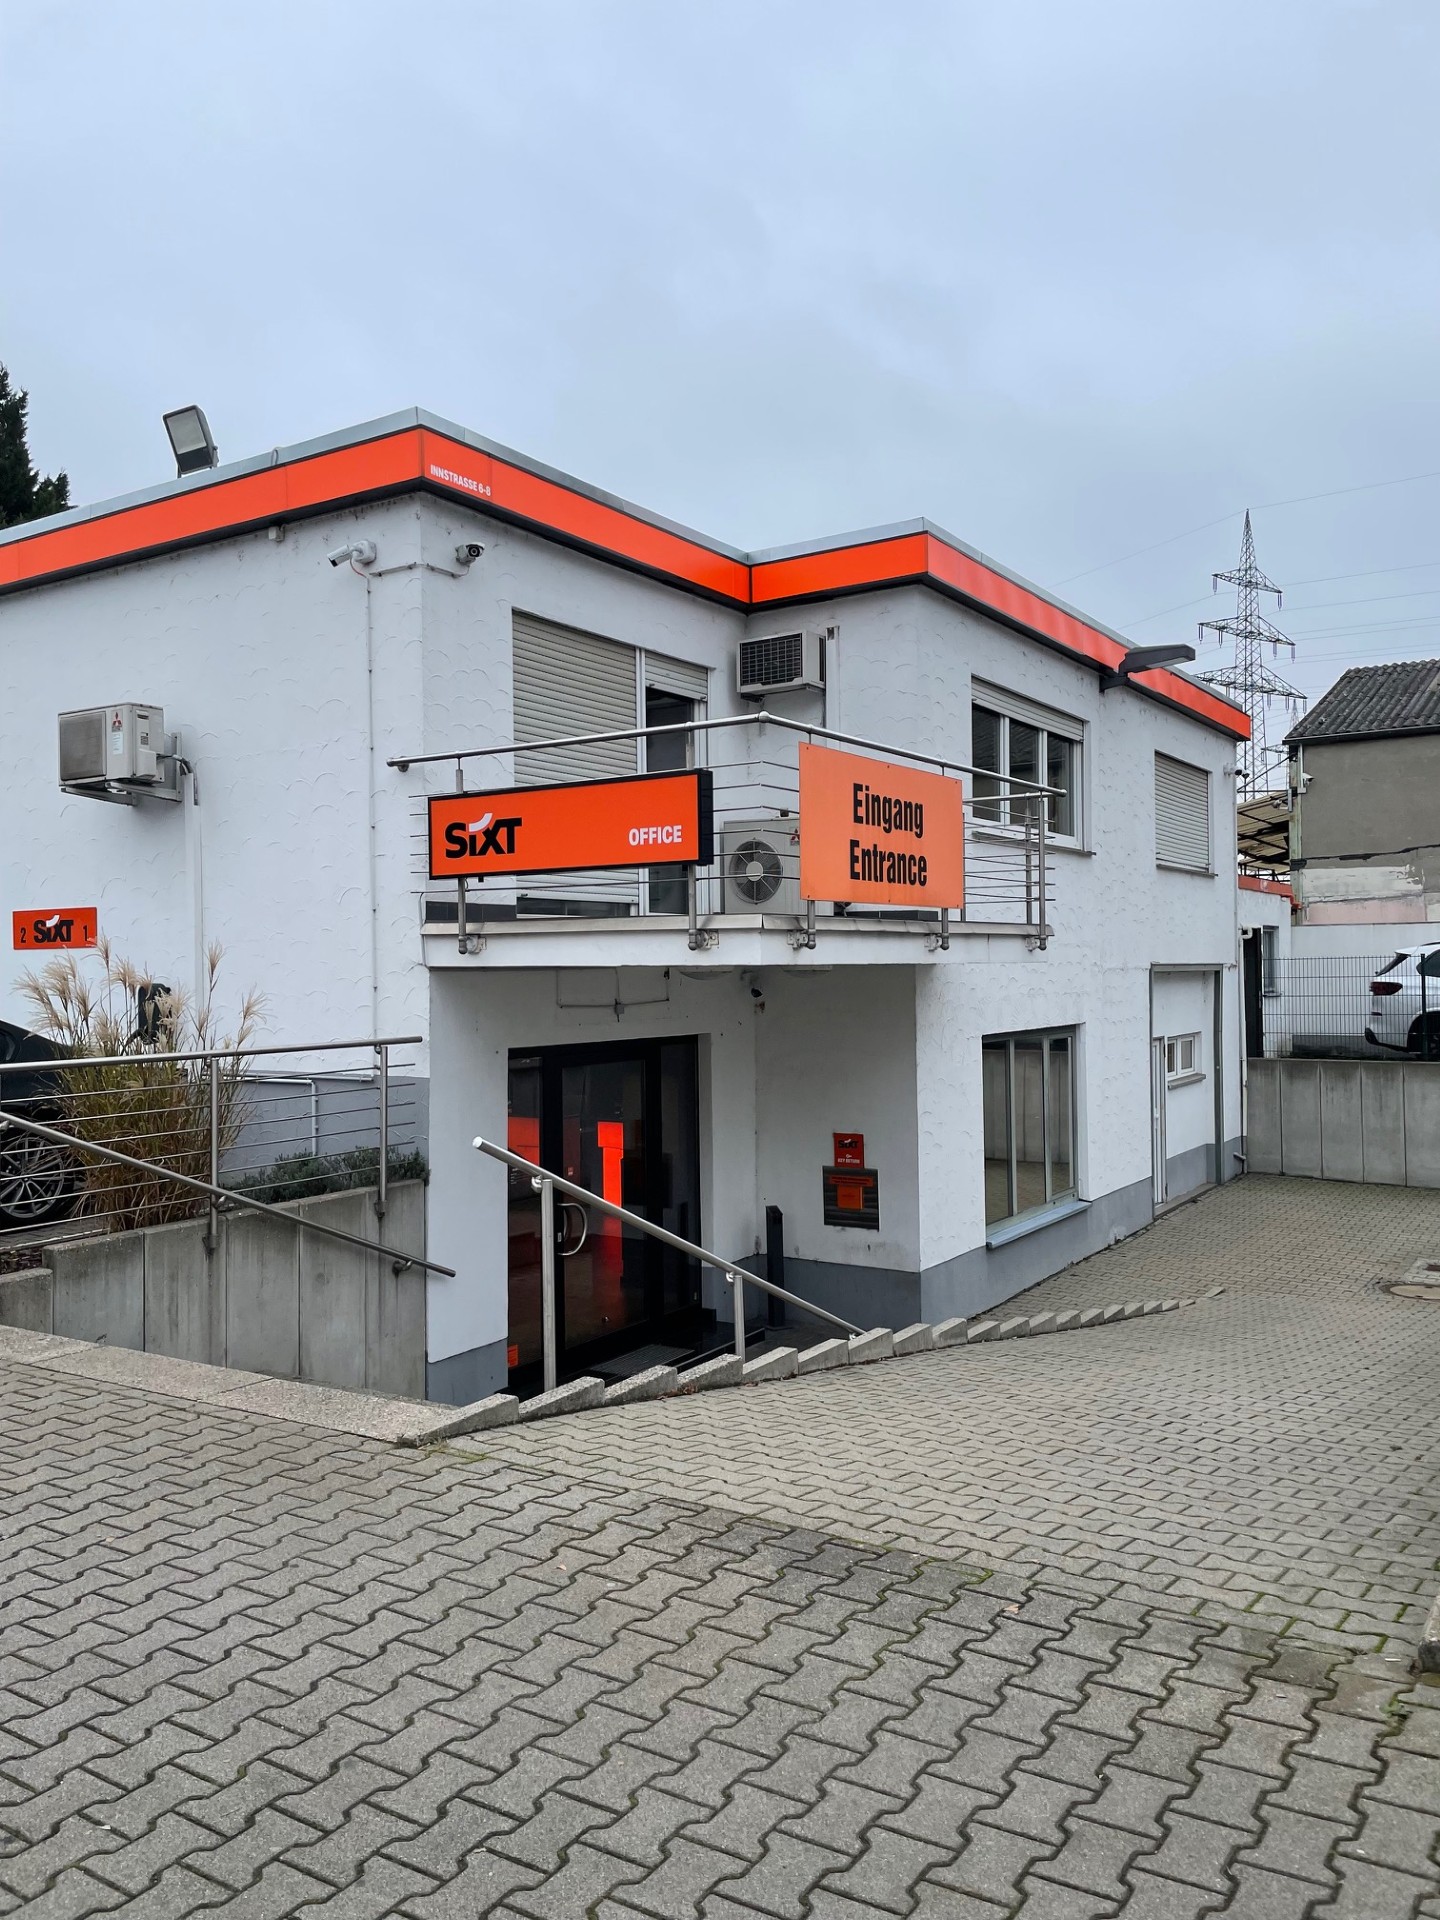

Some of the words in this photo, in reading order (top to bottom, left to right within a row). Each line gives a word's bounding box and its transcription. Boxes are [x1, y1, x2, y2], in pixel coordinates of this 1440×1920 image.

[430, 464, 478, 492] INNSTRASSE
[478, 483, 491, 497] 6-8
[853, 782, 923, 838] Eingang
[628, 825, 682, 846] OFFICE
[849, 839, 927, 886] Entrance
[20, 927, 27, 943] 2
[83, 925, 88, 941] 1
